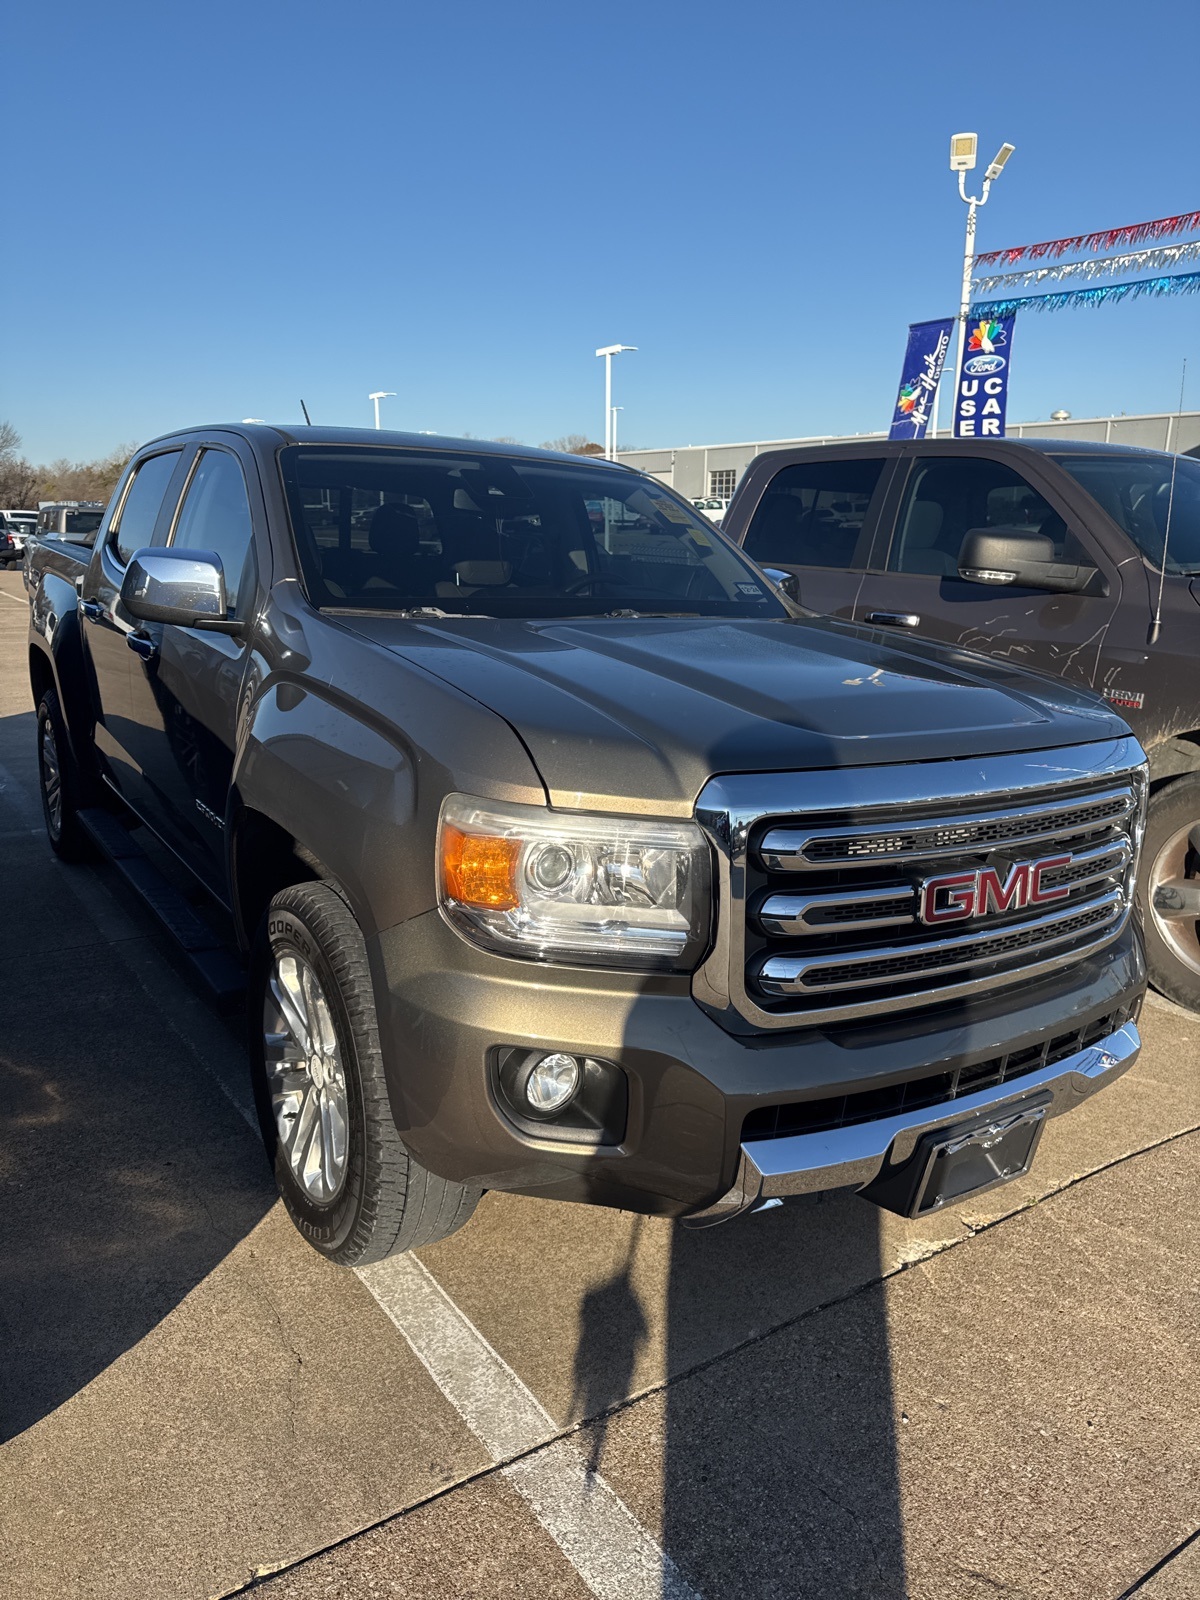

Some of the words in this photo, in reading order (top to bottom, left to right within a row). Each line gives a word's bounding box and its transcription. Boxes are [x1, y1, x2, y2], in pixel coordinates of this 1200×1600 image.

[911, 390, 929, 426] Mac
[920, 330, 944, 391] Haik
[934, 335, 950, 379] DESOTO
[970, 358, 997, 373] Ford
[959, 379, 979, 437] USE
[981, 377, 1003, 435] CAR
[1103, 688, 1145, 709] HEMI
[919, 852, 1073, 926] GMC
[268, 920, 311, 957] OOPER
